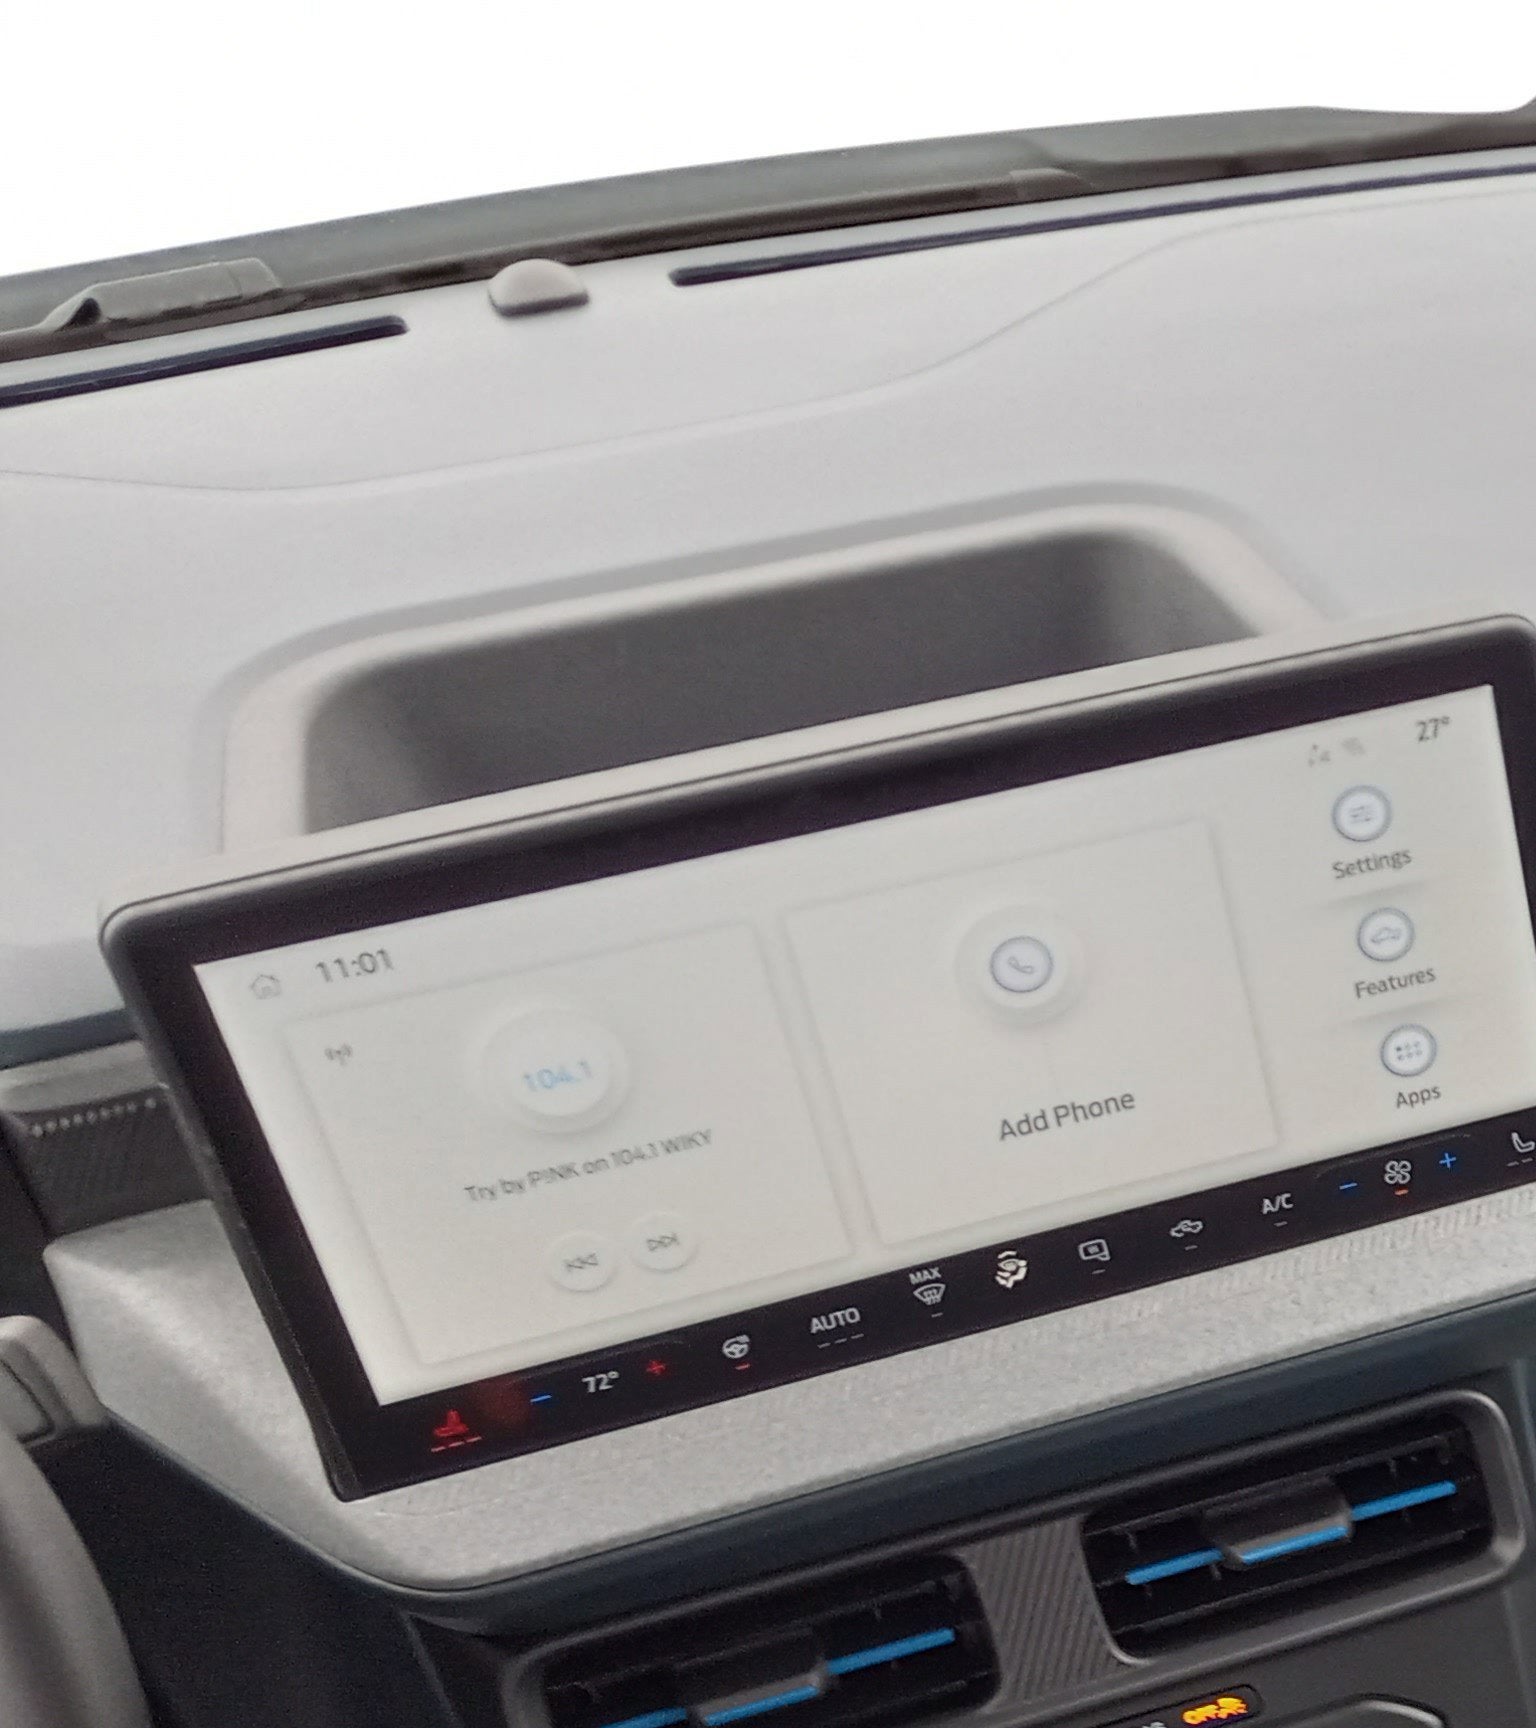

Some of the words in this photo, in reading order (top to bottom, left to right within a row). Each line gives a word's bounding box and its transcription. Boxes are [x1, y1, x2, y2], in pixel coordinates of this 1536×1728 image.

[1331, 847, 1413, 880] Settings
[314, 948, 394, 983] 11:01
[1353, 964, 1437, 998] Features
[1394, 1082, 1442, 1111] Apps
[998, 1107, 1051, 1142] Add
[1054, 1089, 1136, 1128] Phone
[1260, 1192, 1295, 1216] A/C
[909, 1265, 942, 1284] MAX
[809, 1307, 862, 1335] AUTO
